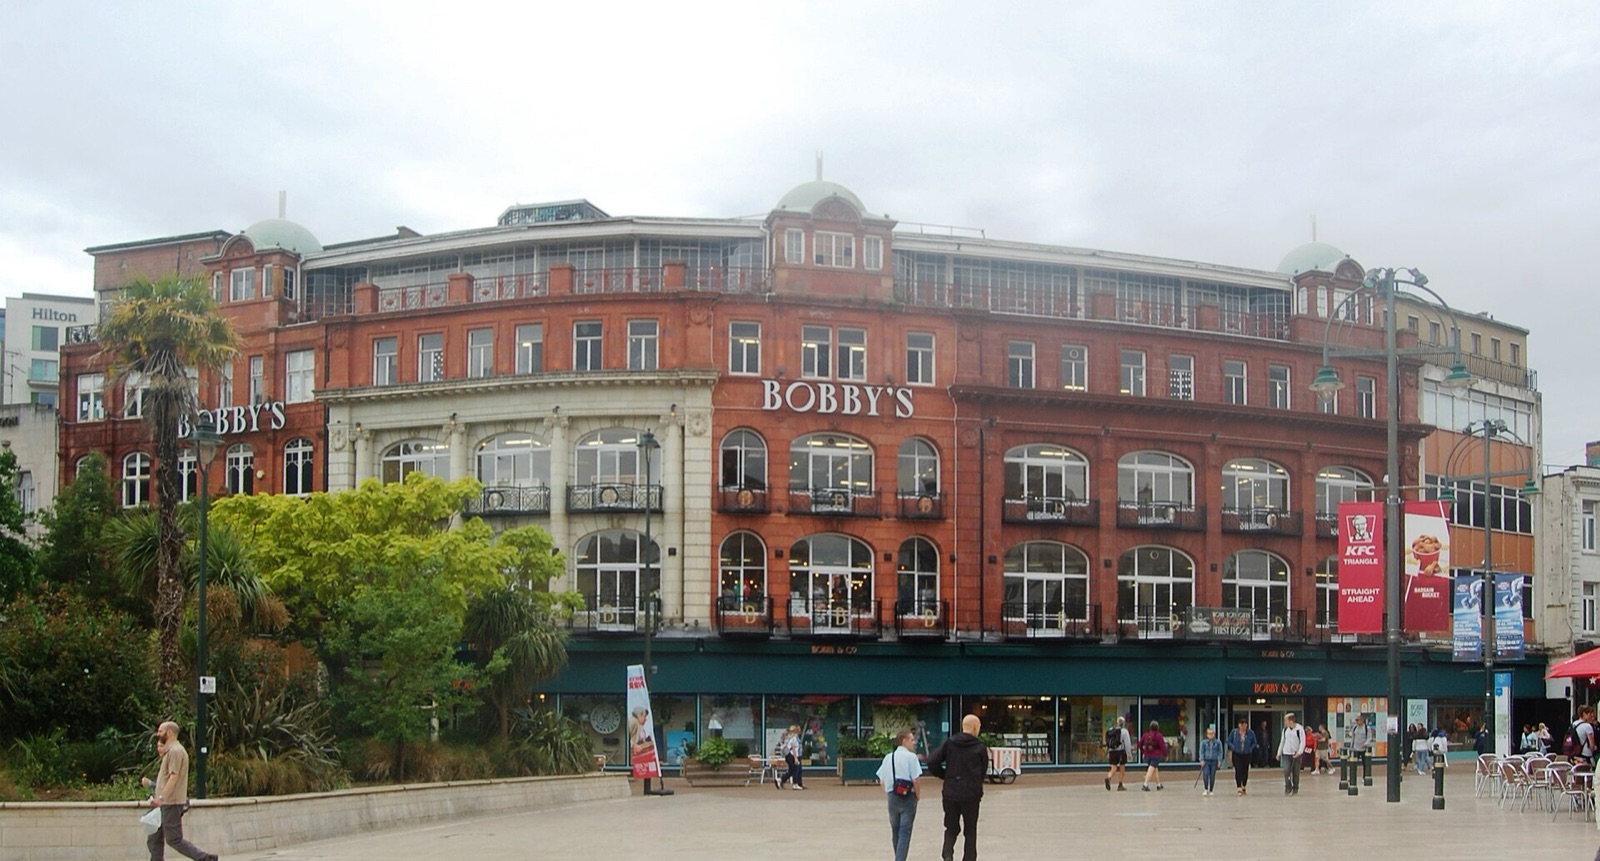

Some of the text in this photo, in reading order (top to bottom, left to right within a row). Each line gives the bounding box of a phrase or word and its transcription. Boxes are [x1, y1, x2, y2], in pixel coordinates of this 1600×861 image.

[32, 307, 77, 322] Hilton
[761, 380, 914, 418] BOBBY'S
[1345, 545, 1376, 556] KFC
[1254, 683, 1279, 693] BOBBY
[1281, 684, 1288, 693] &
